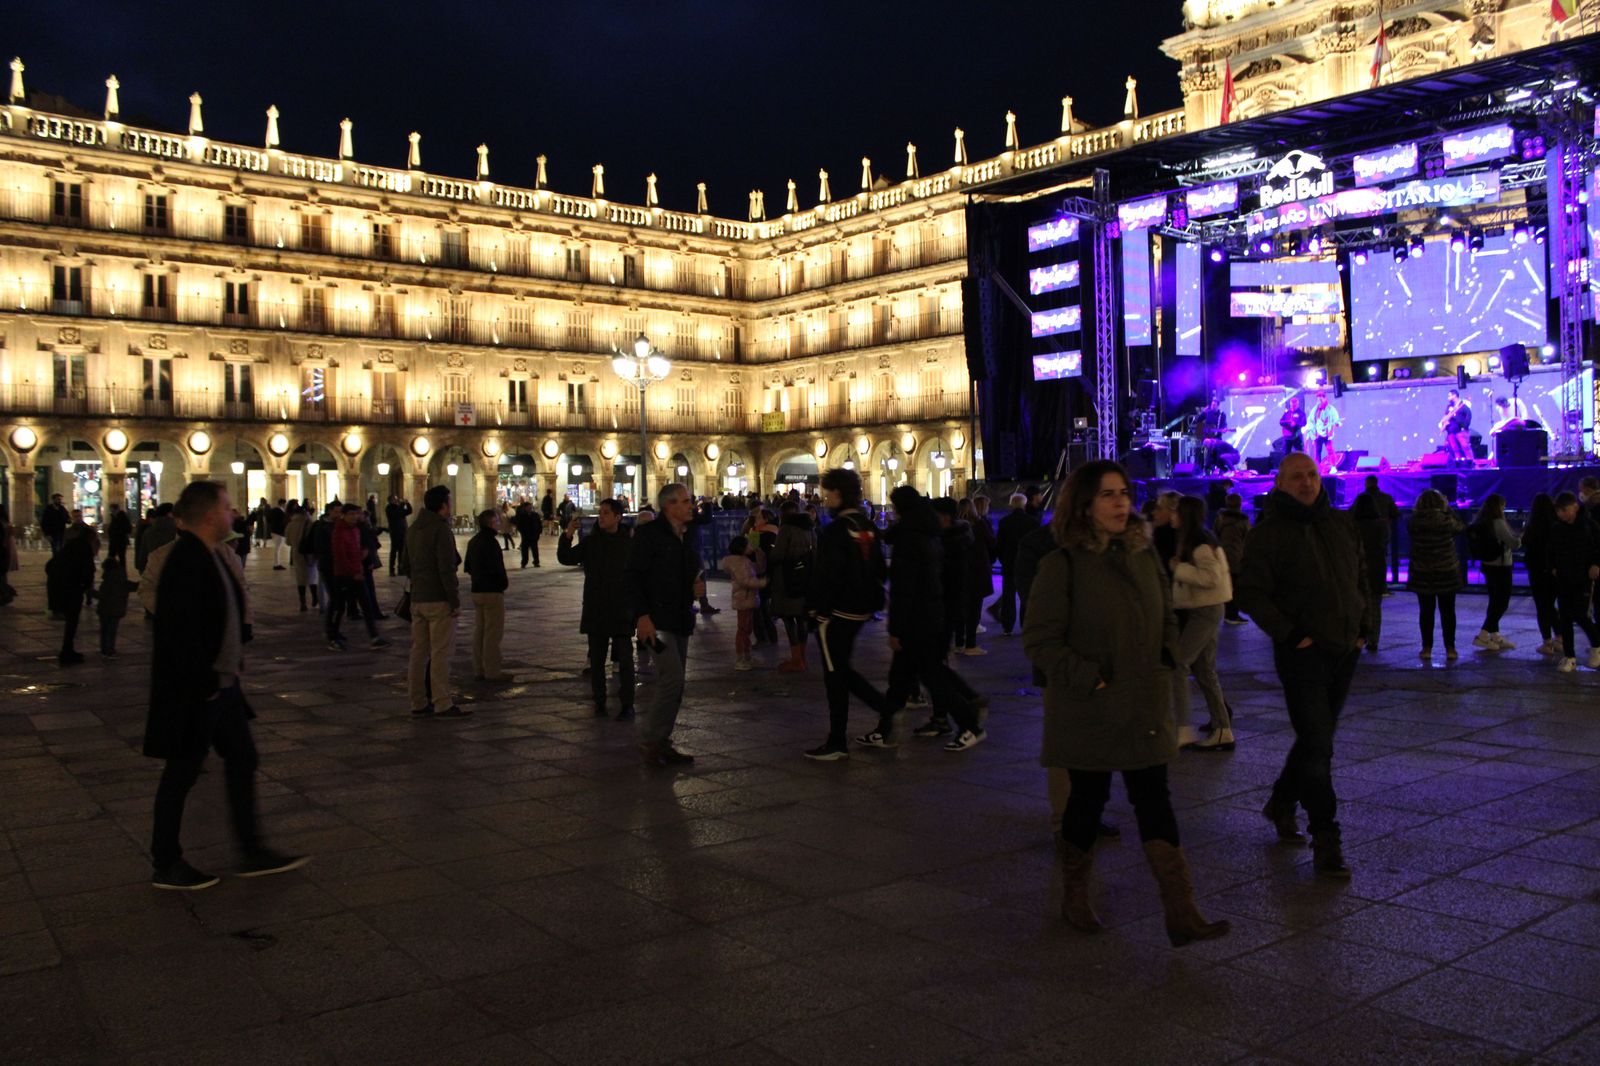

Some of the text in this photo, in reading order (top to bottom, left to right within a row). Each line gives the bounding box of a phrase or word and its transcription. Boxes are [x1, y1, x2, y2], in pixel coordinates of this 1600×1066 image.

[1260, 179, 1296, 206] Red
[1297, 171, 1334, 200] Bull
[1263, 217, 1279, 230] DE
